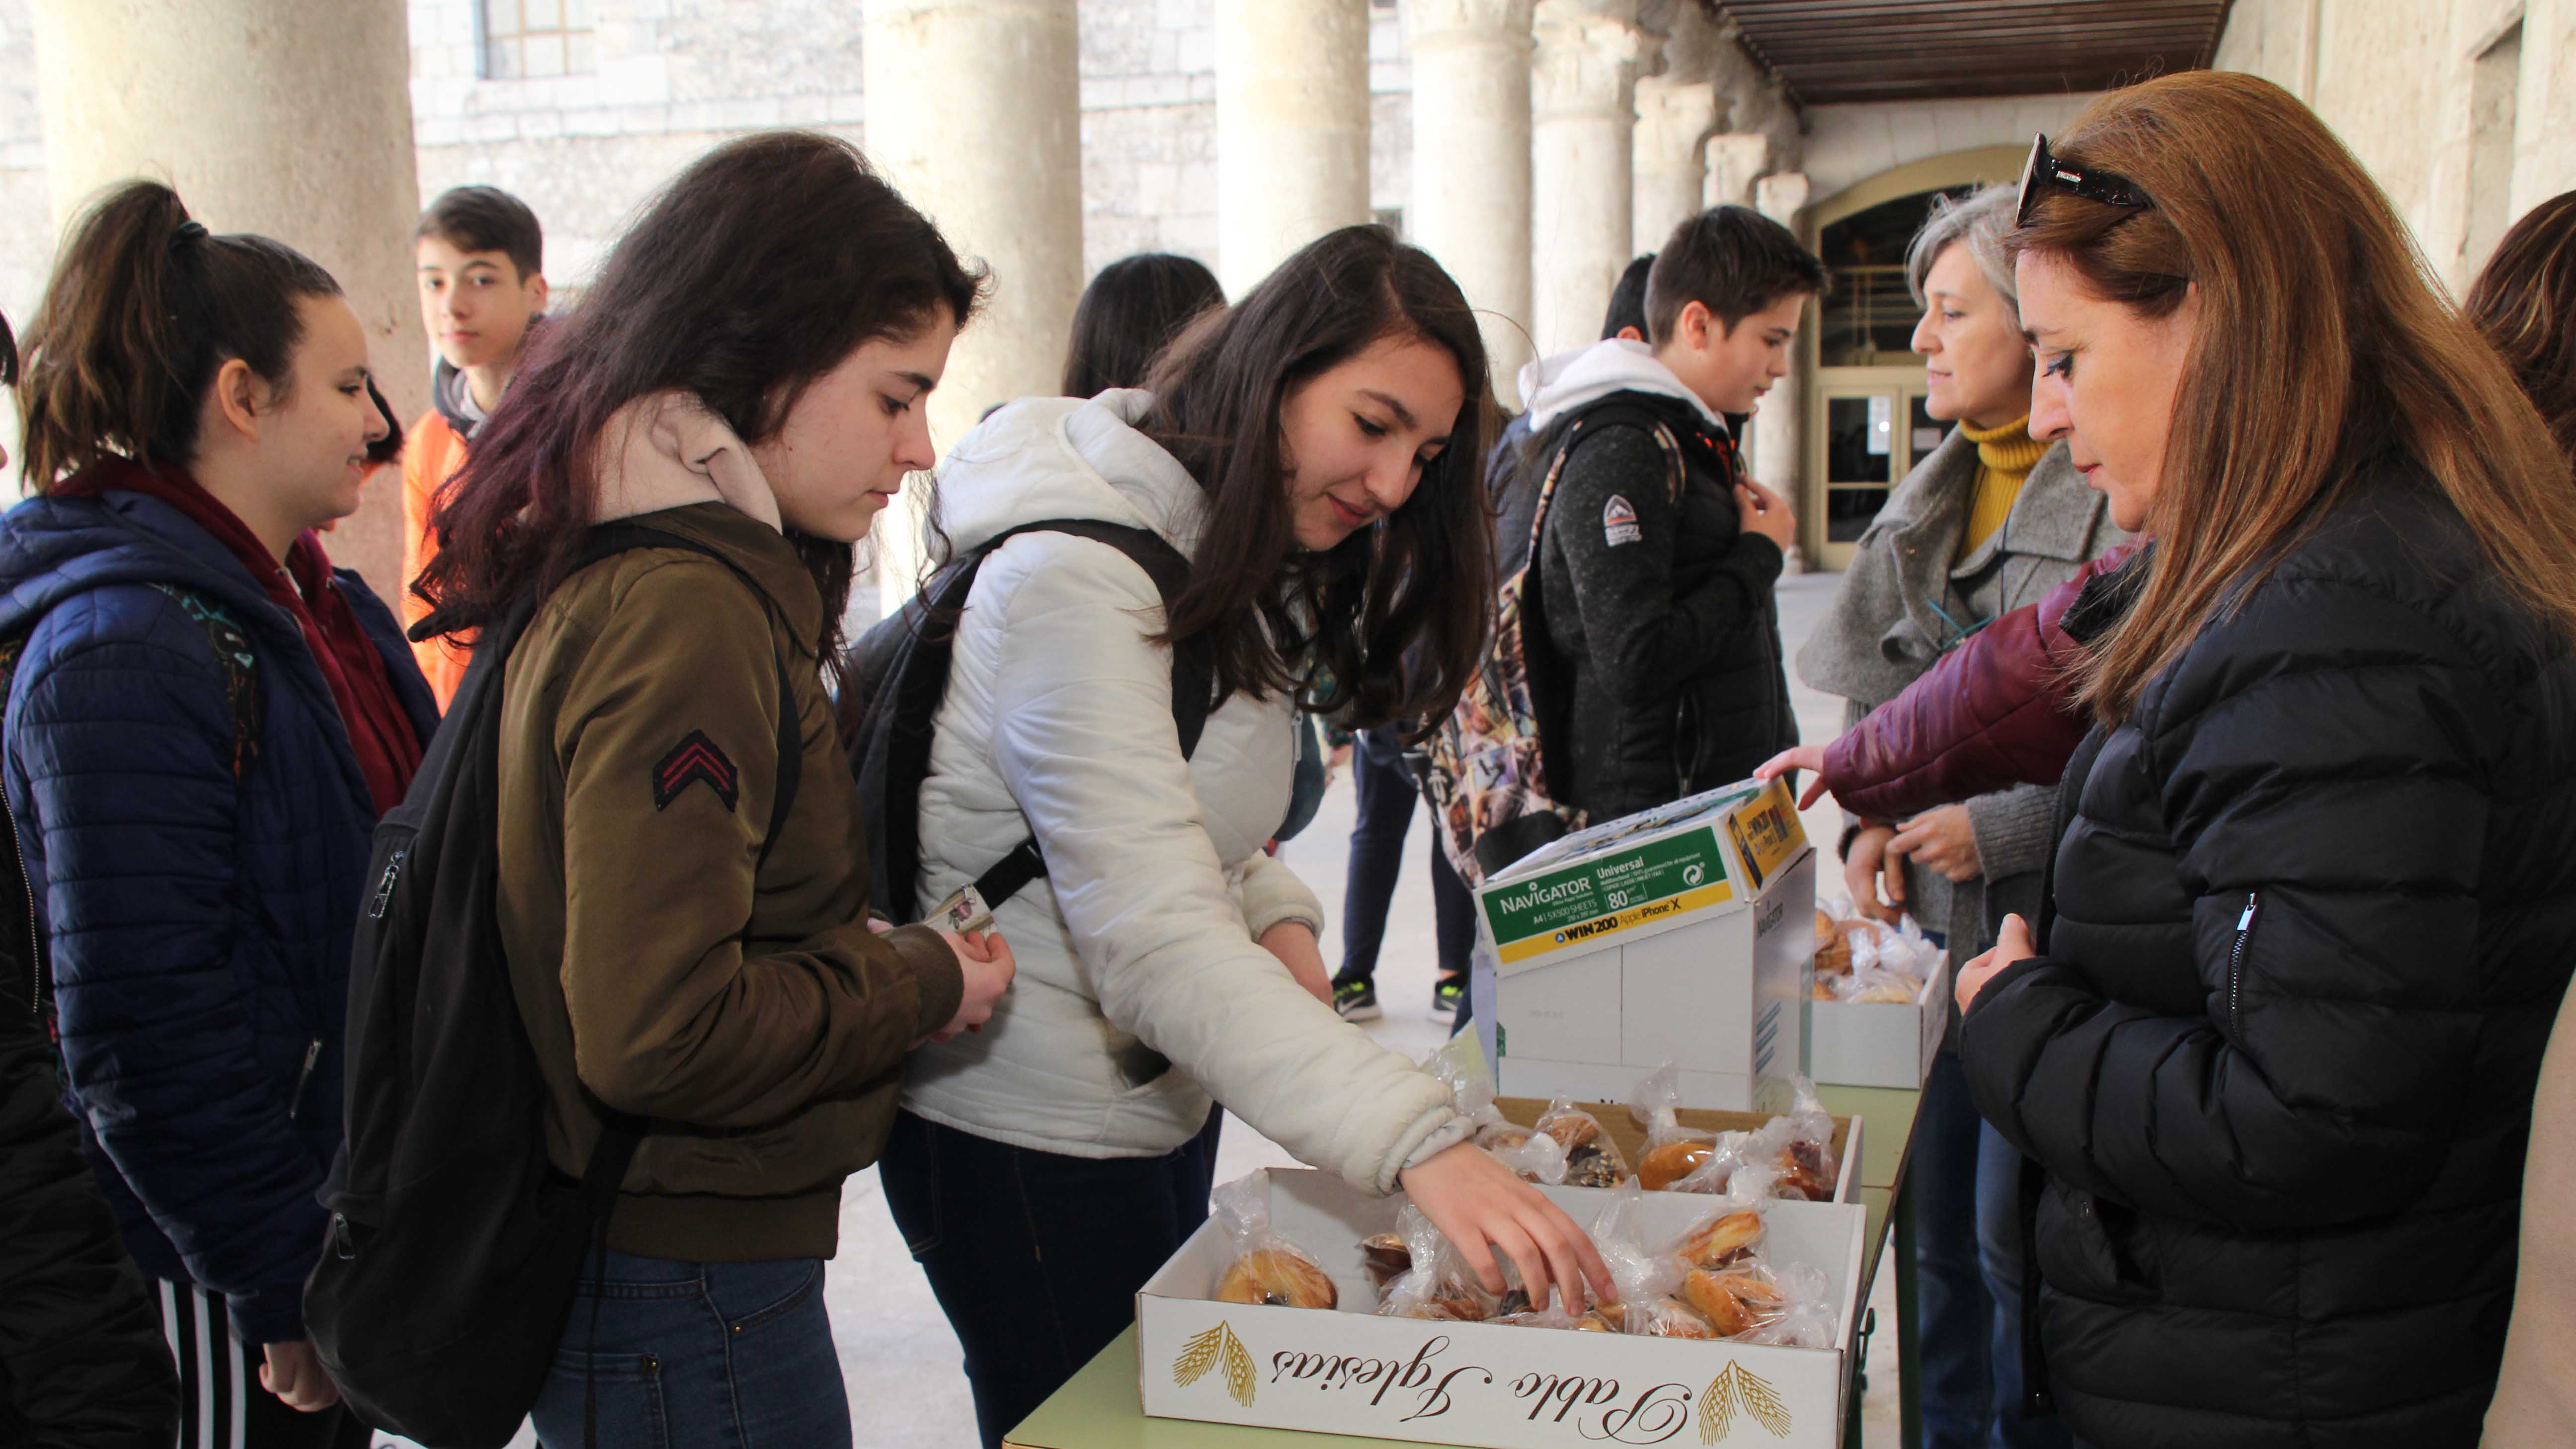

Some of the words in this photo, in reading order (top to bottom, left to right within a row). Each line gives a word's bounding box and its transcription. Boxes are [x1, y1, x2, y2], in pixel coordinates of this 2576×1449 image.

[1597, 855, 1644, 879] Universal
[1500, 877, 1591, 914] NAVIGATOR
[1533, 914, 1543, 924] A4
[1570, 898, 1598, 913] SHEETS
[1608, 890, 1628, 909] 80
[1565, 923, 1595, 941] WIN
[1594, 917, 1618, 933] 200
[1620, 911, 1640, 925] Apple
[1641, 903, 1669, 918] iPhone
[1671, 898, 1682, 910] X
[1271, 1335, 1493, 1423] Iglesias
[1507, 1372, 1692, 1445] Pablo
